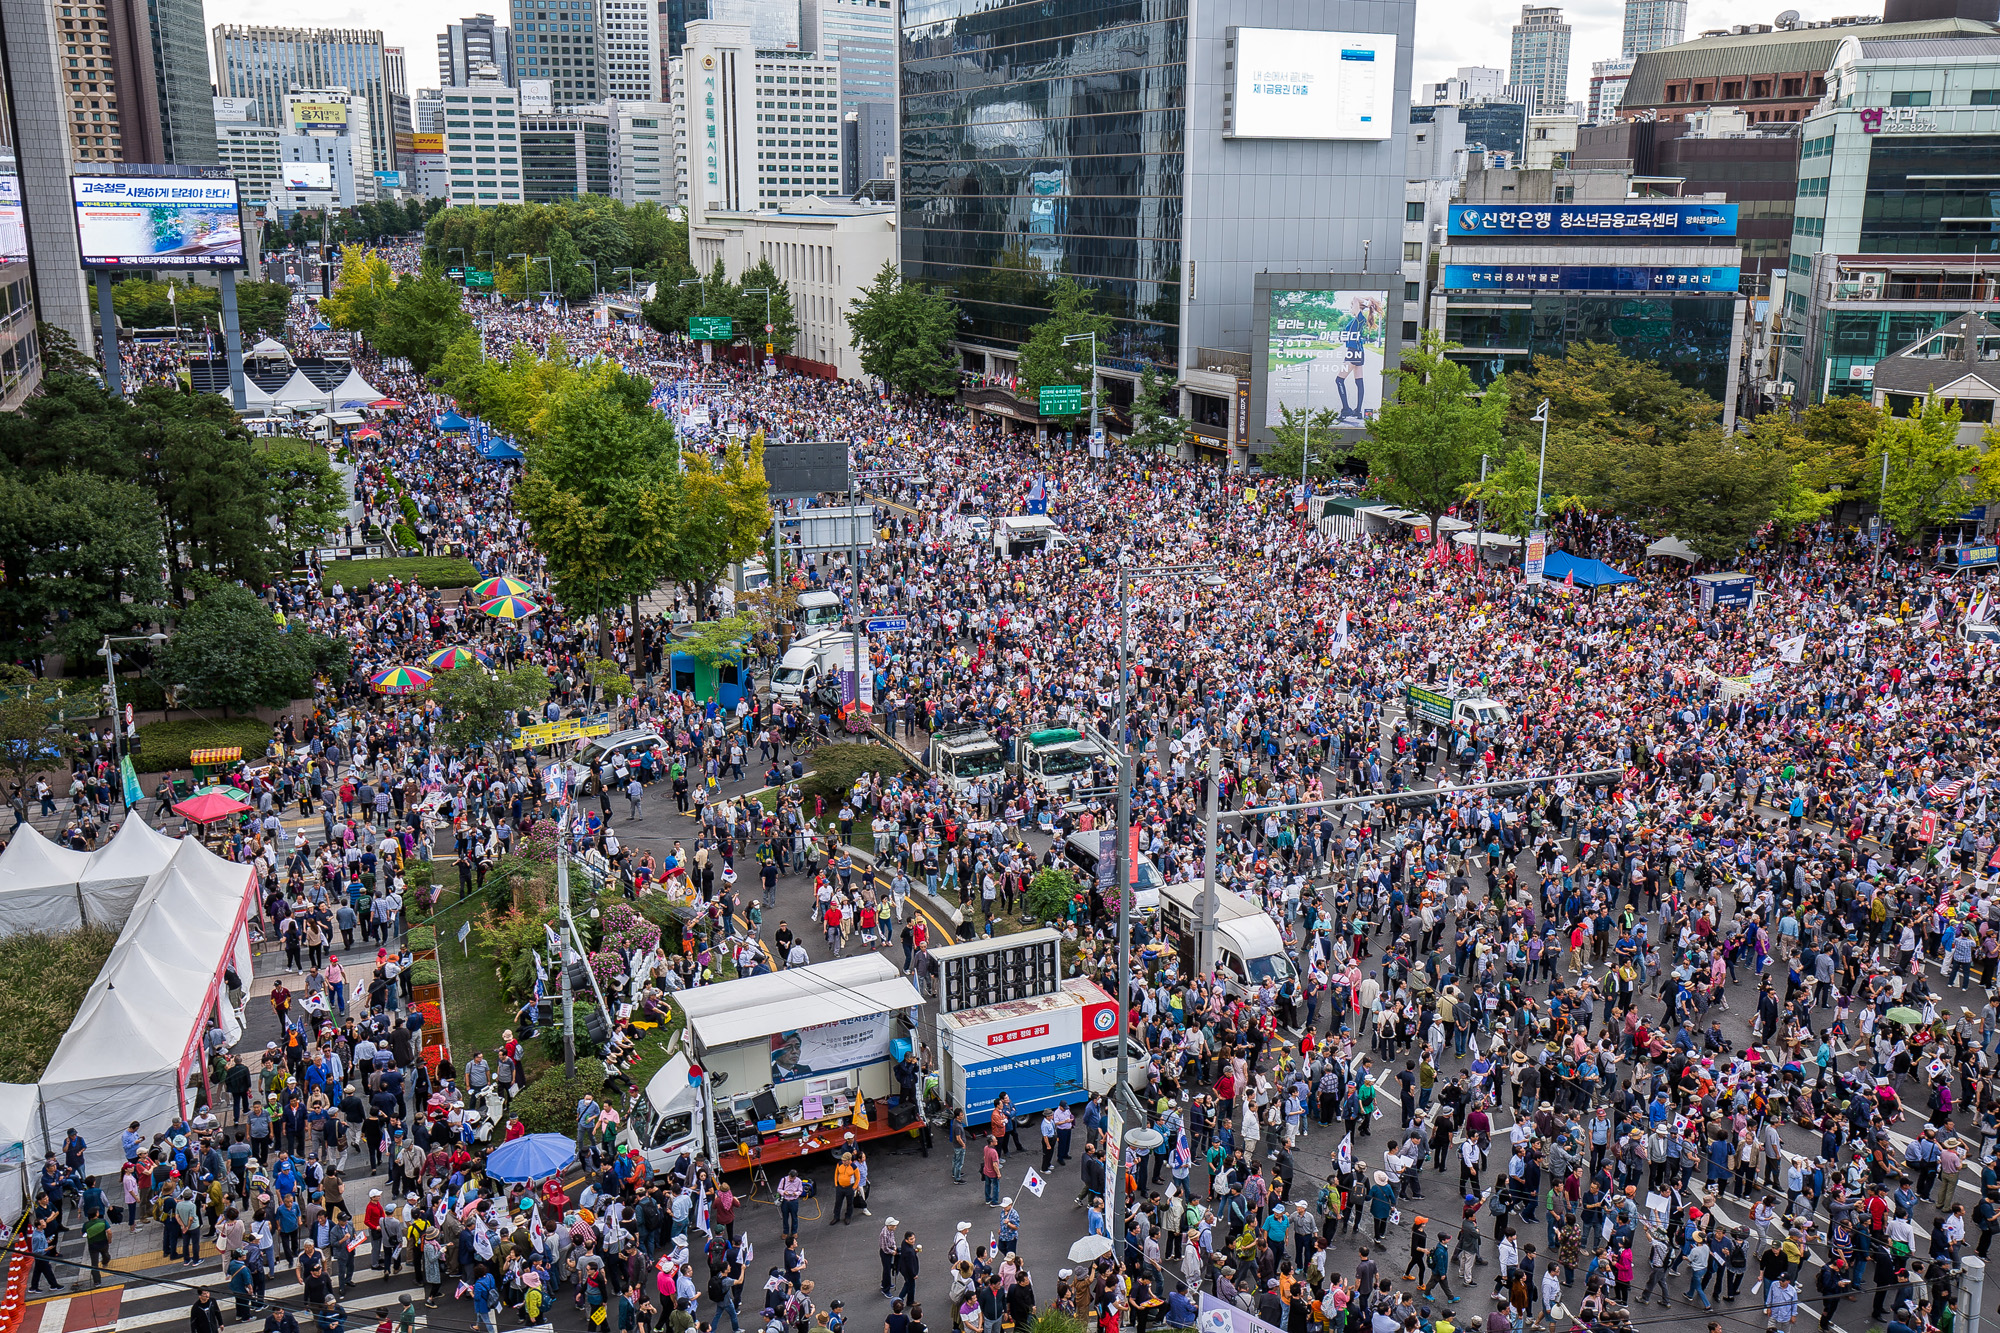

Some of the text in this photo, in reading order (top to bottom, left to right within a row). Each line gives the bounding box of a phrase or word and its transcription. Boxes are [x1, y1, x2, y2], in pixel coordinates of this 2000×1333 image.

[1605, 63, 1630, 71] FRASER
[1263, 71, 1289, 82] 손에서
[1253, 84, 1309, 96] 제 1금융권 대출
[301, 110, 324, 121] 을지
[1860, 107, 1884, 133] 연
[1885, 107, 1919, 124] 치과
[705, 76, 718, 185] 서울특별시의회
[1884, 123, 1938, 132] 722-8272
[82, 182, 230, 198] 고속철은 시원하게 달려야 한다!
[1481, 211, 1726, 229] 신한은행 청소년금융교육센터 광화문캠퍼스
[1472, 272, 1560, 283] 한국금융사박물관
[1654, 274, 1711, 284] 신한갤러리
[1277, 319, 1328, 330] 달리는 나는
[1320, 331, 1361, 342] 아름답다
[1277, 340, 1312, 348] 2019
[1276, 350, 1362, 359] CHUNCHEON
[992, 1026, 1045, 1043] 자유 생명 정의 공정
[977, 1068, 992, 1076] 국민은
[992, 1064, 1014, 1074] 자신들의
[1041, 1054, 1056, 1064] 정부를
[1057, 1052, 1072, 1060] 가진다
